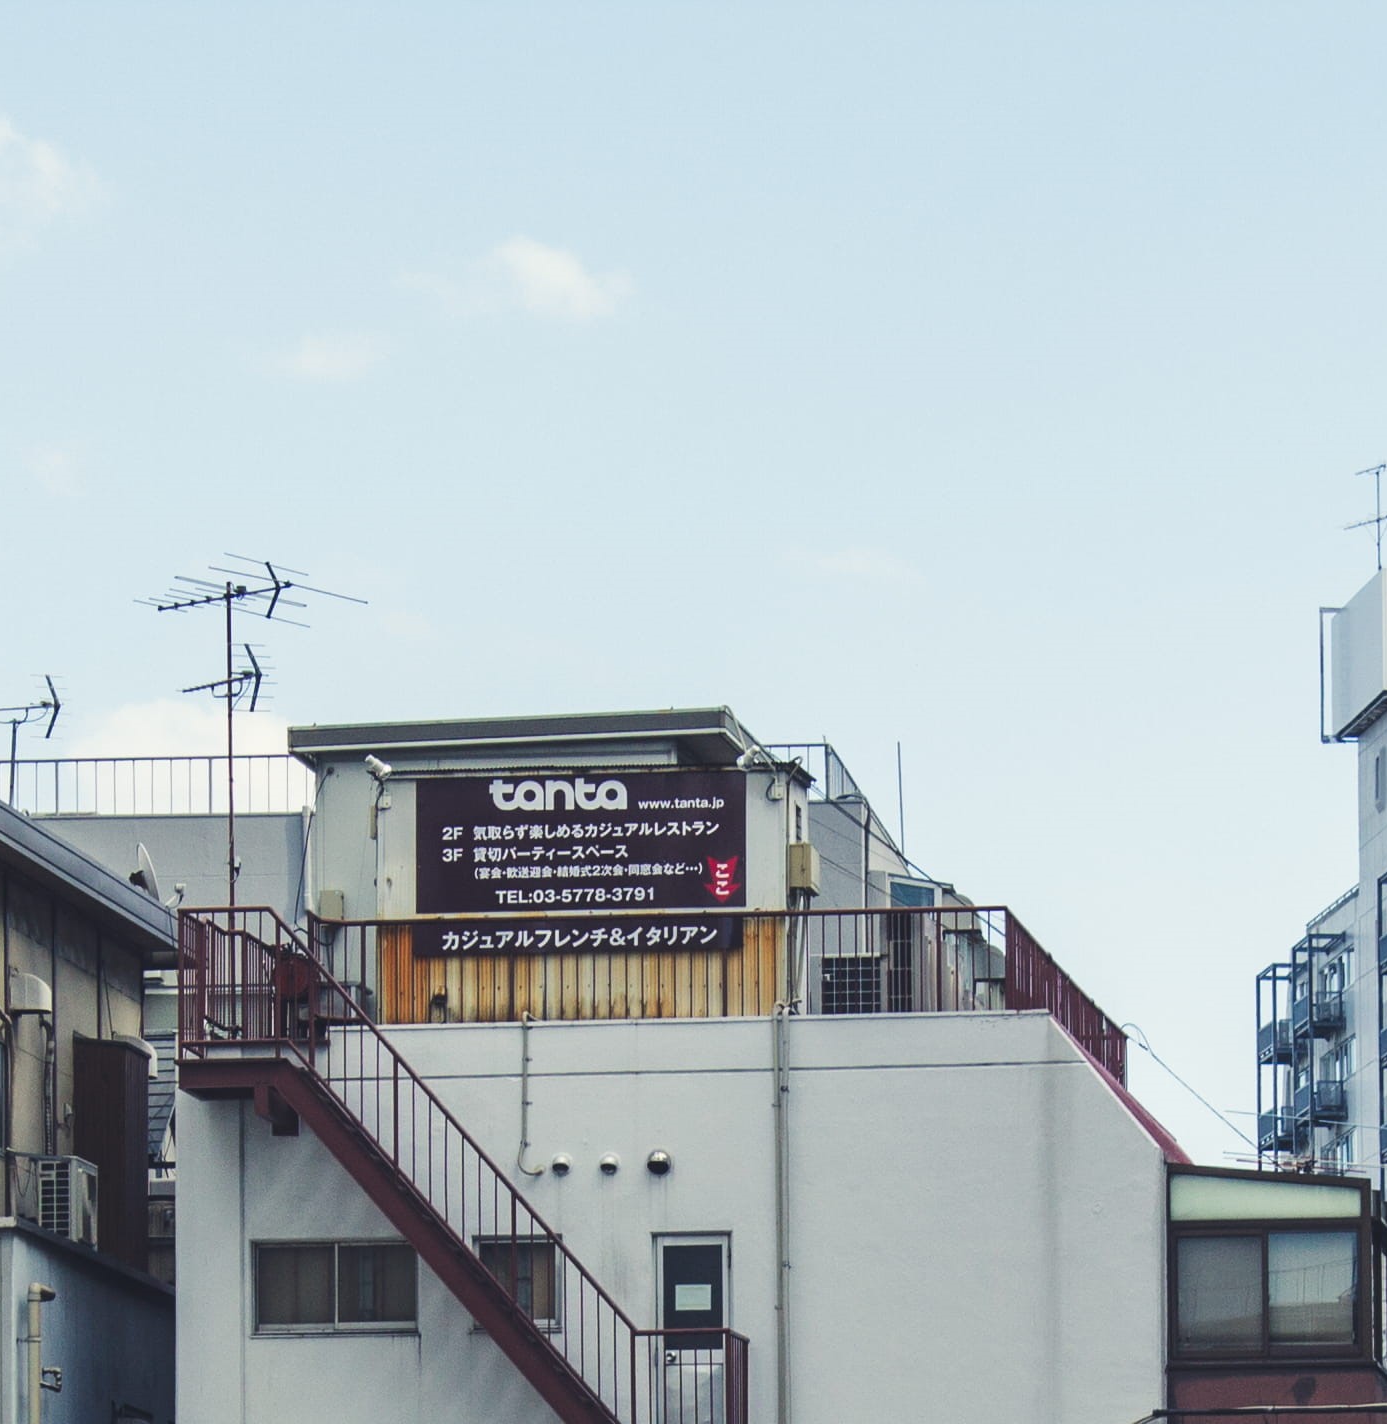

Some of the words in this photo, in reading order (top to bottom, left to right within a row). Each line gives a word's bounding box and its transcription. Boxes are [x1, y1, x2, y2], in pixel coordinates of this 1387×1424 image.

[489, 778, 628, 811] tanta
[638, 797, 724, 810] www.tanta.jp
[442, 827, 463, 840] 2F
[473, 822, 720, 840] 気取らず楽しめるカジュアルレストラン
[442, 848, 463, 862] 3F
[473, 845, 629, 862] 貸切パーティースペース
[715, 863, 730, 896] ここ
[495, 887, 655, 904] TEL:03-5778-3791
[442, 926, 717, 950] カジュアルフレンチ&イタリアン
